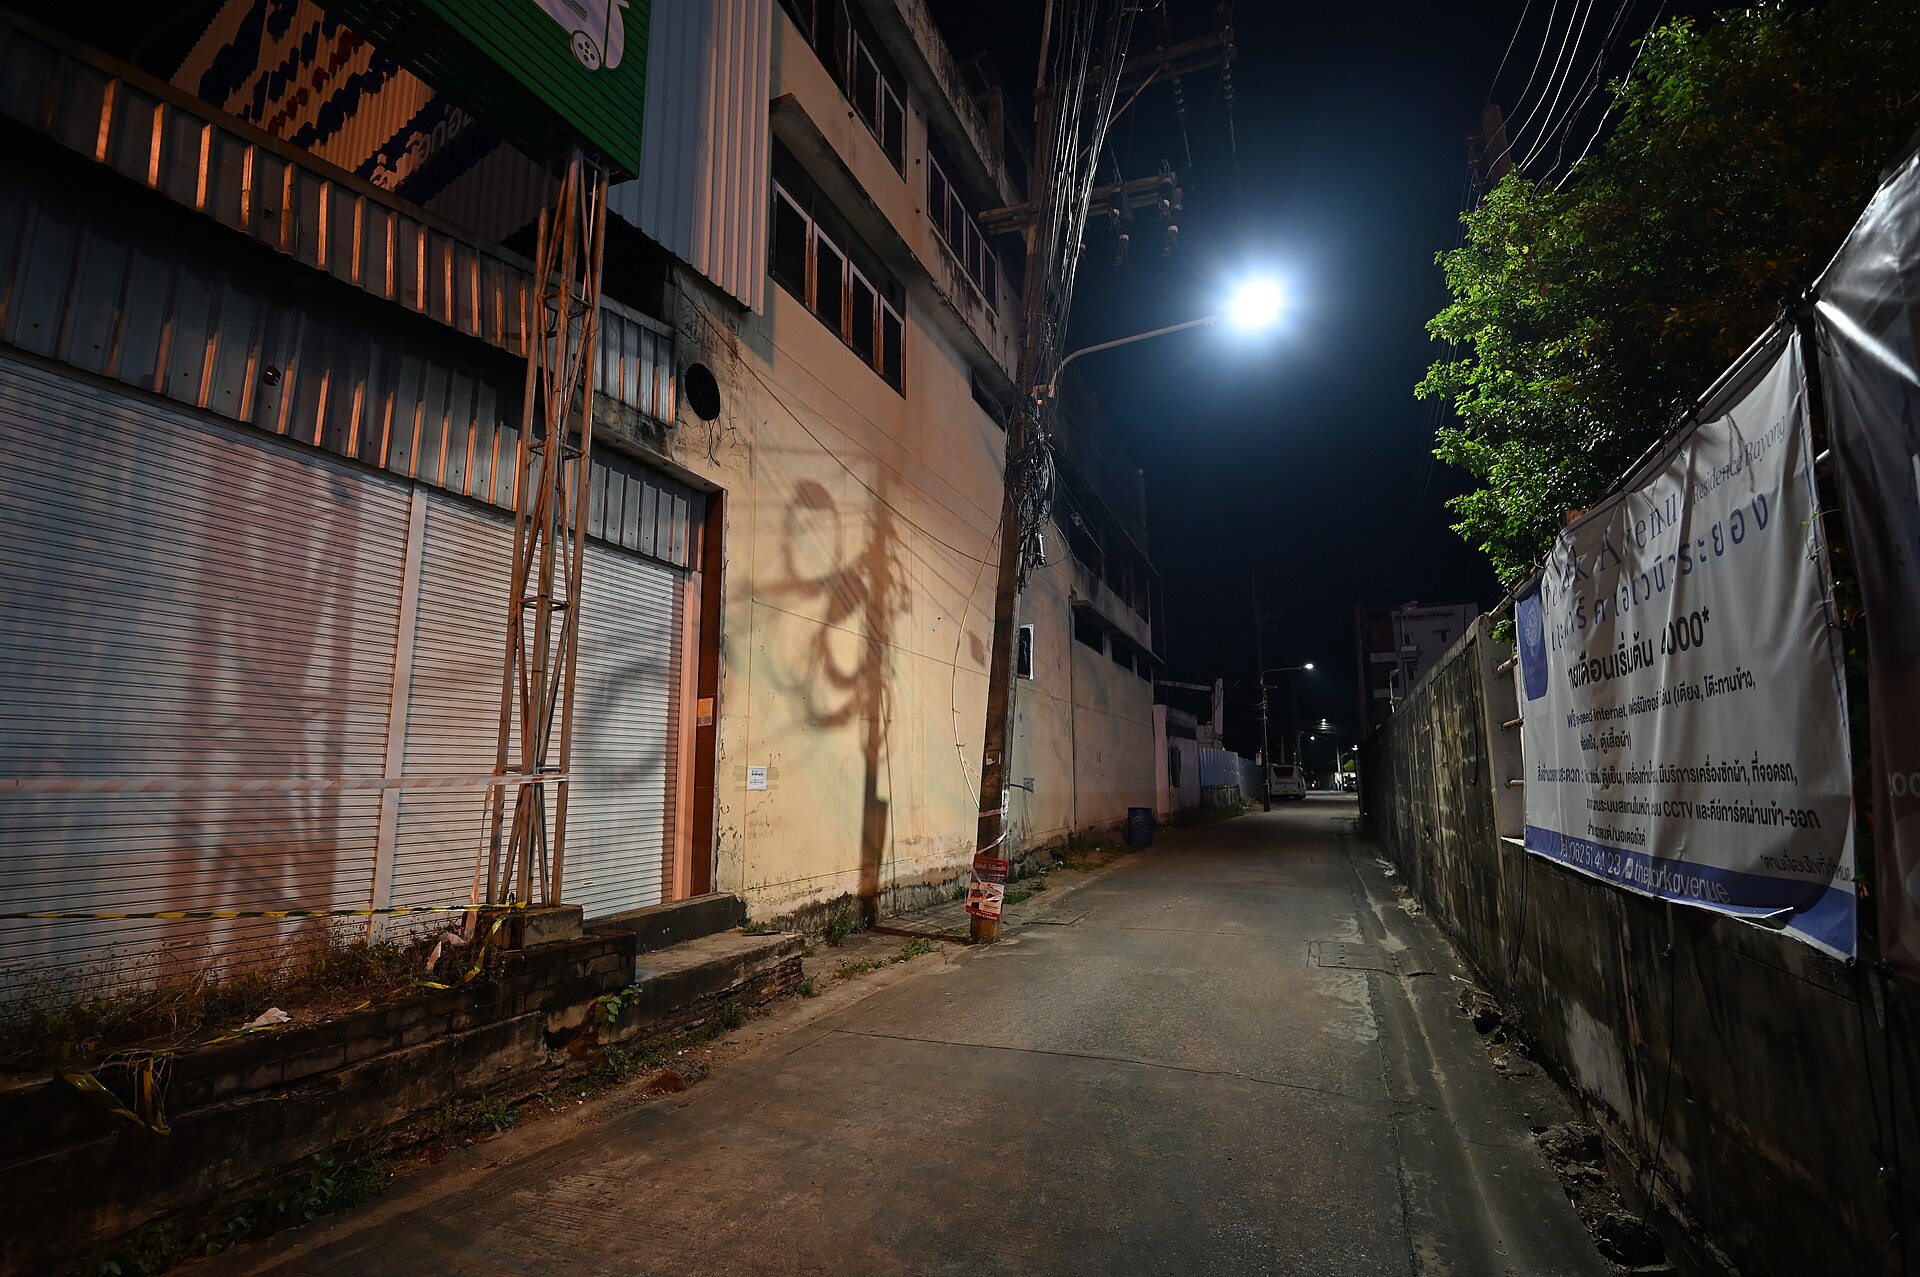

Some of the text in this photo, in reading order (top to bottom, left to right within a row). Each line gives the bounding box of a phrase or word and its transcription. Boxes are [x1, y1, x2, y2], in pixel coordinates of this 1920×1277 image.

[1692, 455, 1742, 505] Residence
[1744, 415, 1785, 467] Rayong
[1568, 632, 1655, 690] ายเดือนเริ่มต้น
[1593, 704, 1628, 721] internet,
[1704, 666, 1756, 698] โต๊ะทานข้าว,
[1658, 755, 1750, 786] มีบริการเครื่องซักผ้า,
[1750, 750, 1798, 786] ที่จอดรถ,
[1663, 800, 1693, 819] CCTV
